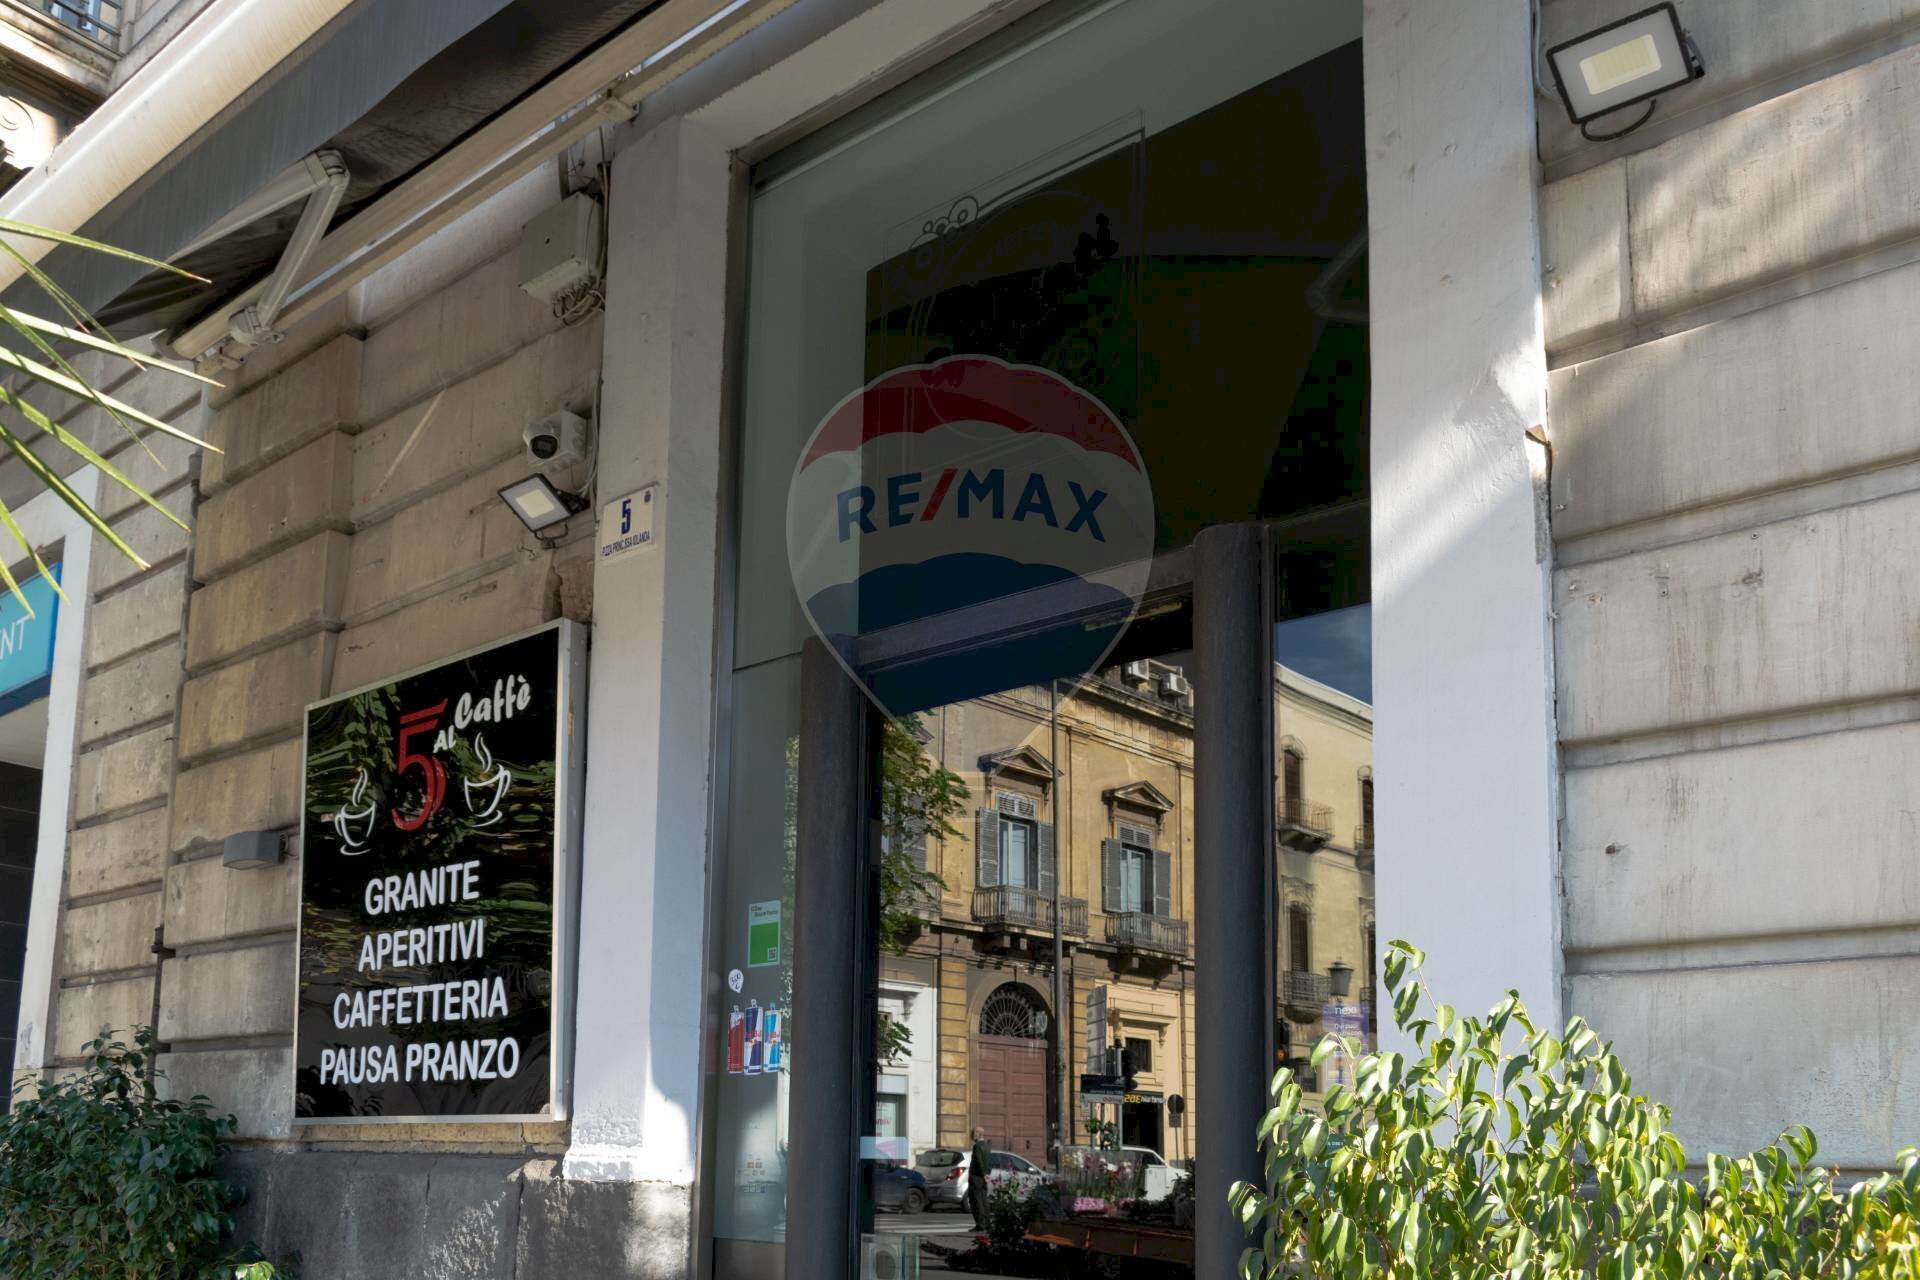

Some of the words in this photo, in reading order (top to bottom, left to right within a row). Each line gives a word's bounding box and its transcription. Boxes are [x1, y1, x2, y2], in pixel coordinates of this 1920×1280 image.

[621, 498, 631, 534] 5
[0, 614, 31, 661] NT
[454, 674, 531, 730] Caffè
[391, 697, 449, 832] 5
[364, 859, 481, 916] GRANITE
[358, 918, 485, 973] APERITIVI
[333, 976, 509, 1030] CAFFETTERIA
[320, 1044, 400, 1086] PAUSA
[405, 1036, 520, 1083] PRANZO
